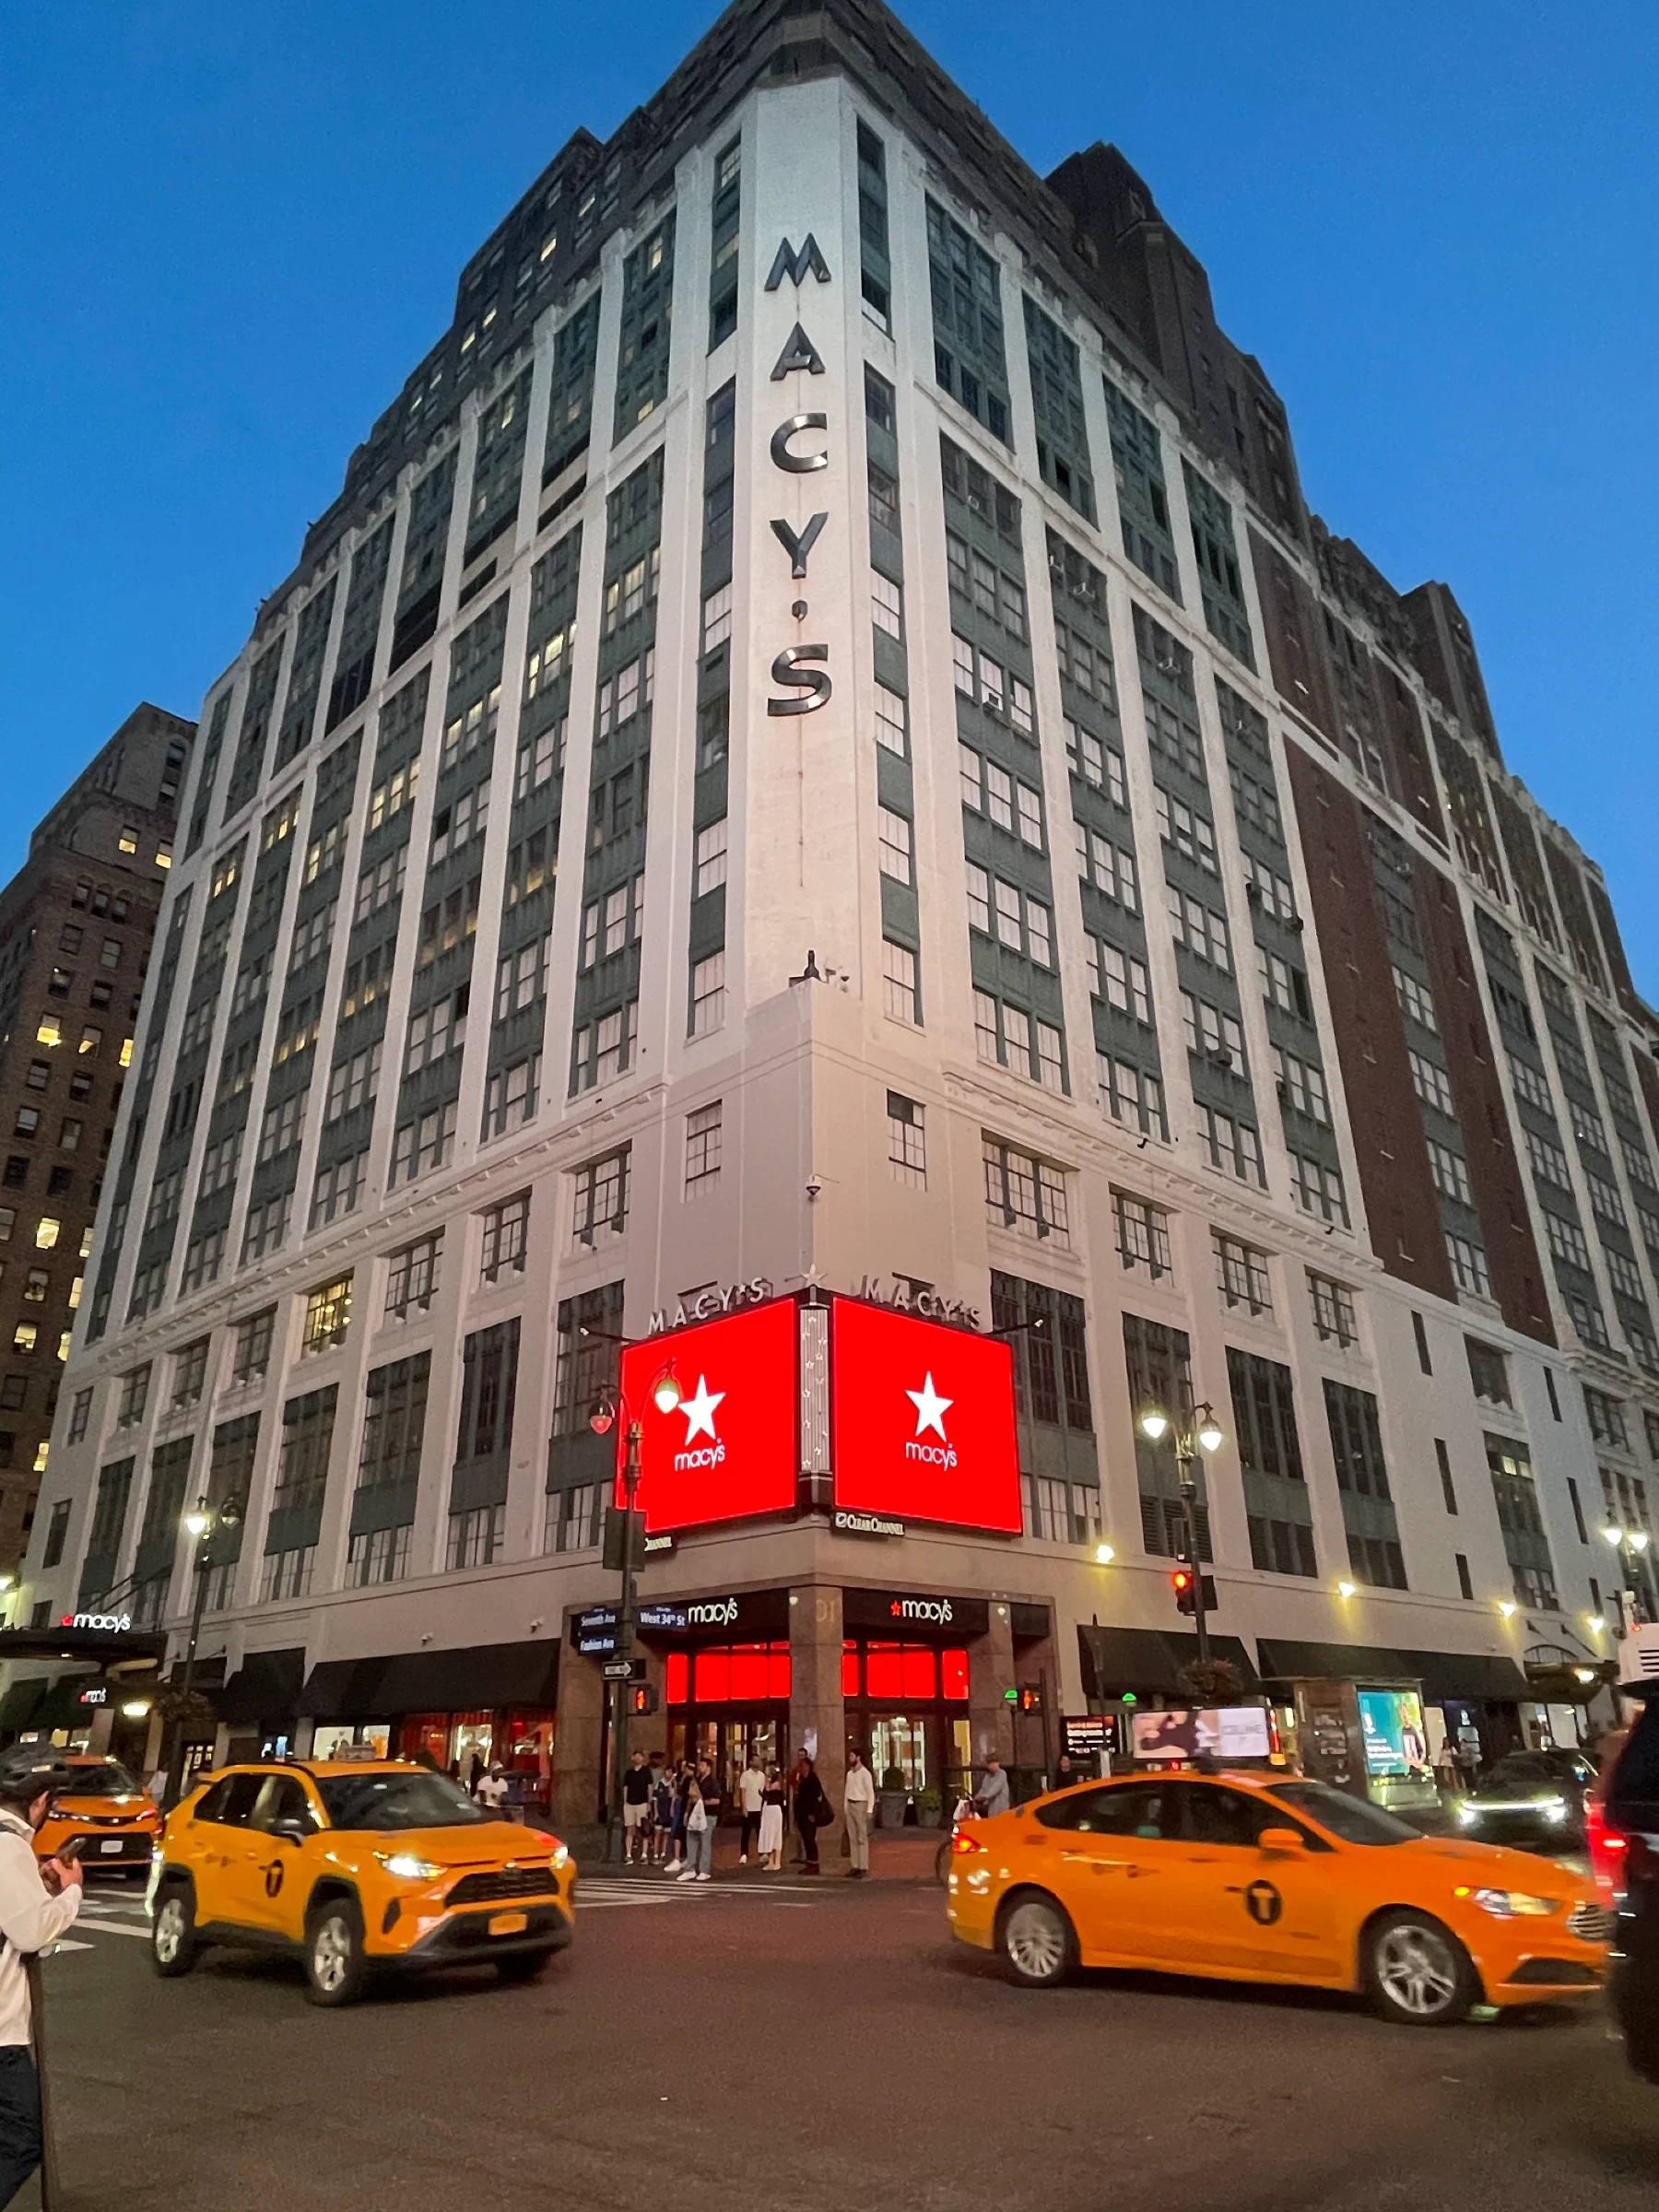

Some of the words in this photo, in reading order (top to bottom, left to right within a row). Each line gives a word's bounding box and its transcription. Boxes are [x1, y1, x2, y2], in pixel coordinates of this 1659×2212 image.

[764, 232, 831, 716] MACY'S
[674, 1438, 726, 1472] macy's
[905, 1442, 958, 1472] macy's
[73, 1613, 131, 1633] macy's
[640, 1611, 660, 1624] West
[677, 1615, 686, 1627] St
[688, 1597, 738, 1626] macy's
[901, 1598, 953, 1625] macy's
